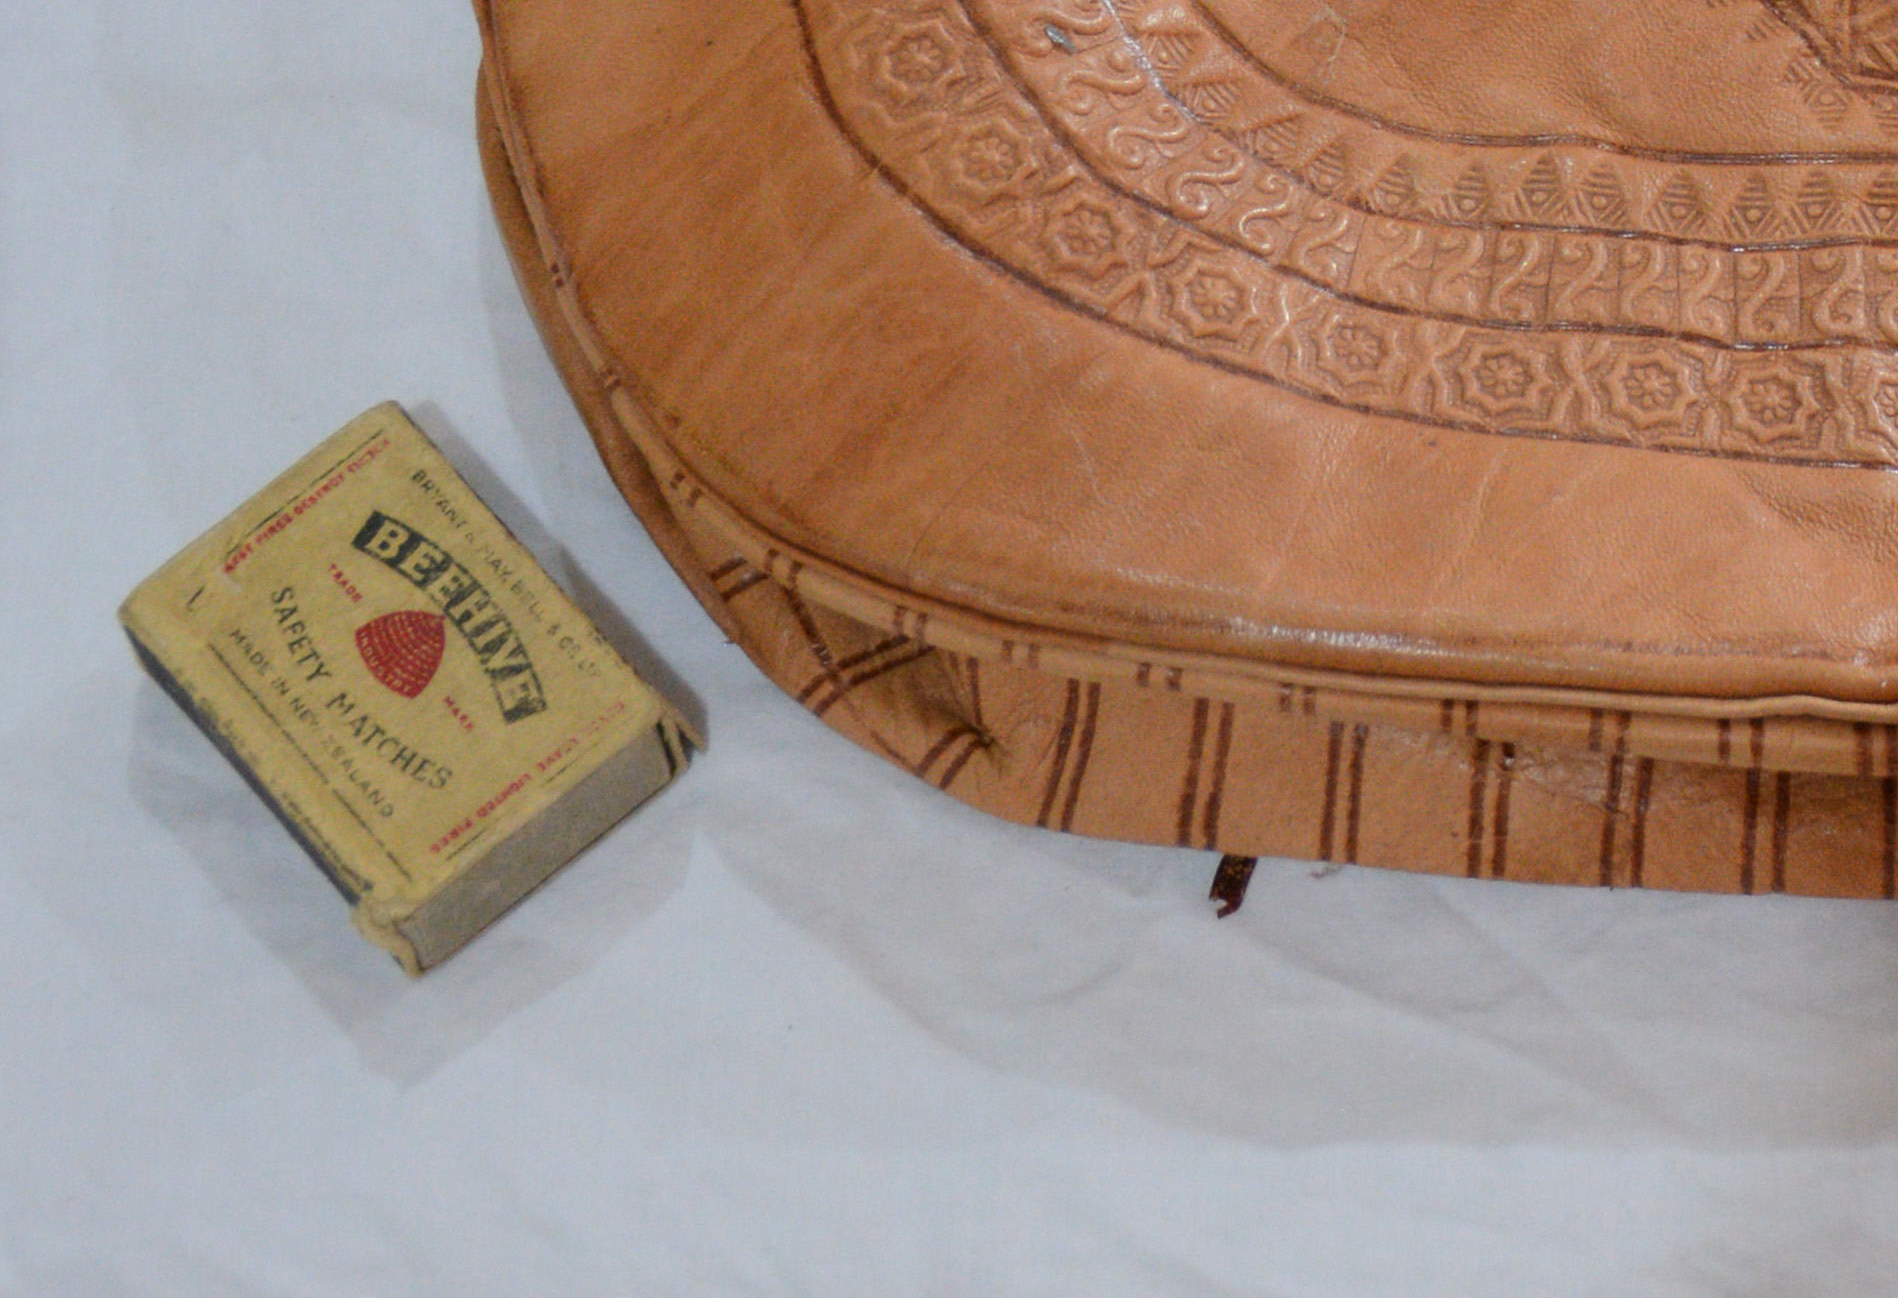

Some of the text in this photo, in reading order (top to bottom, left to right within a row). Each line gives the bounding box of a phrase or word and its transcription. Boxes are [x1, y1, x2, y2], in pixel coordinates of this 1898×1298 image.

[411, 469, 468, 530] BRYANT
[271, 586, 453, 789] SAFETY MATCHES
[329, 562, 475, 733] TRADE MARK
[356, 629, 412, 694] INDUSTRY
[358, 513, 546, 721] BEEHIVE
[229, 628, 272, 676] MADE
[271, 676, 291, 697] IN
[321, 735, 395, 818] ZEALAND
